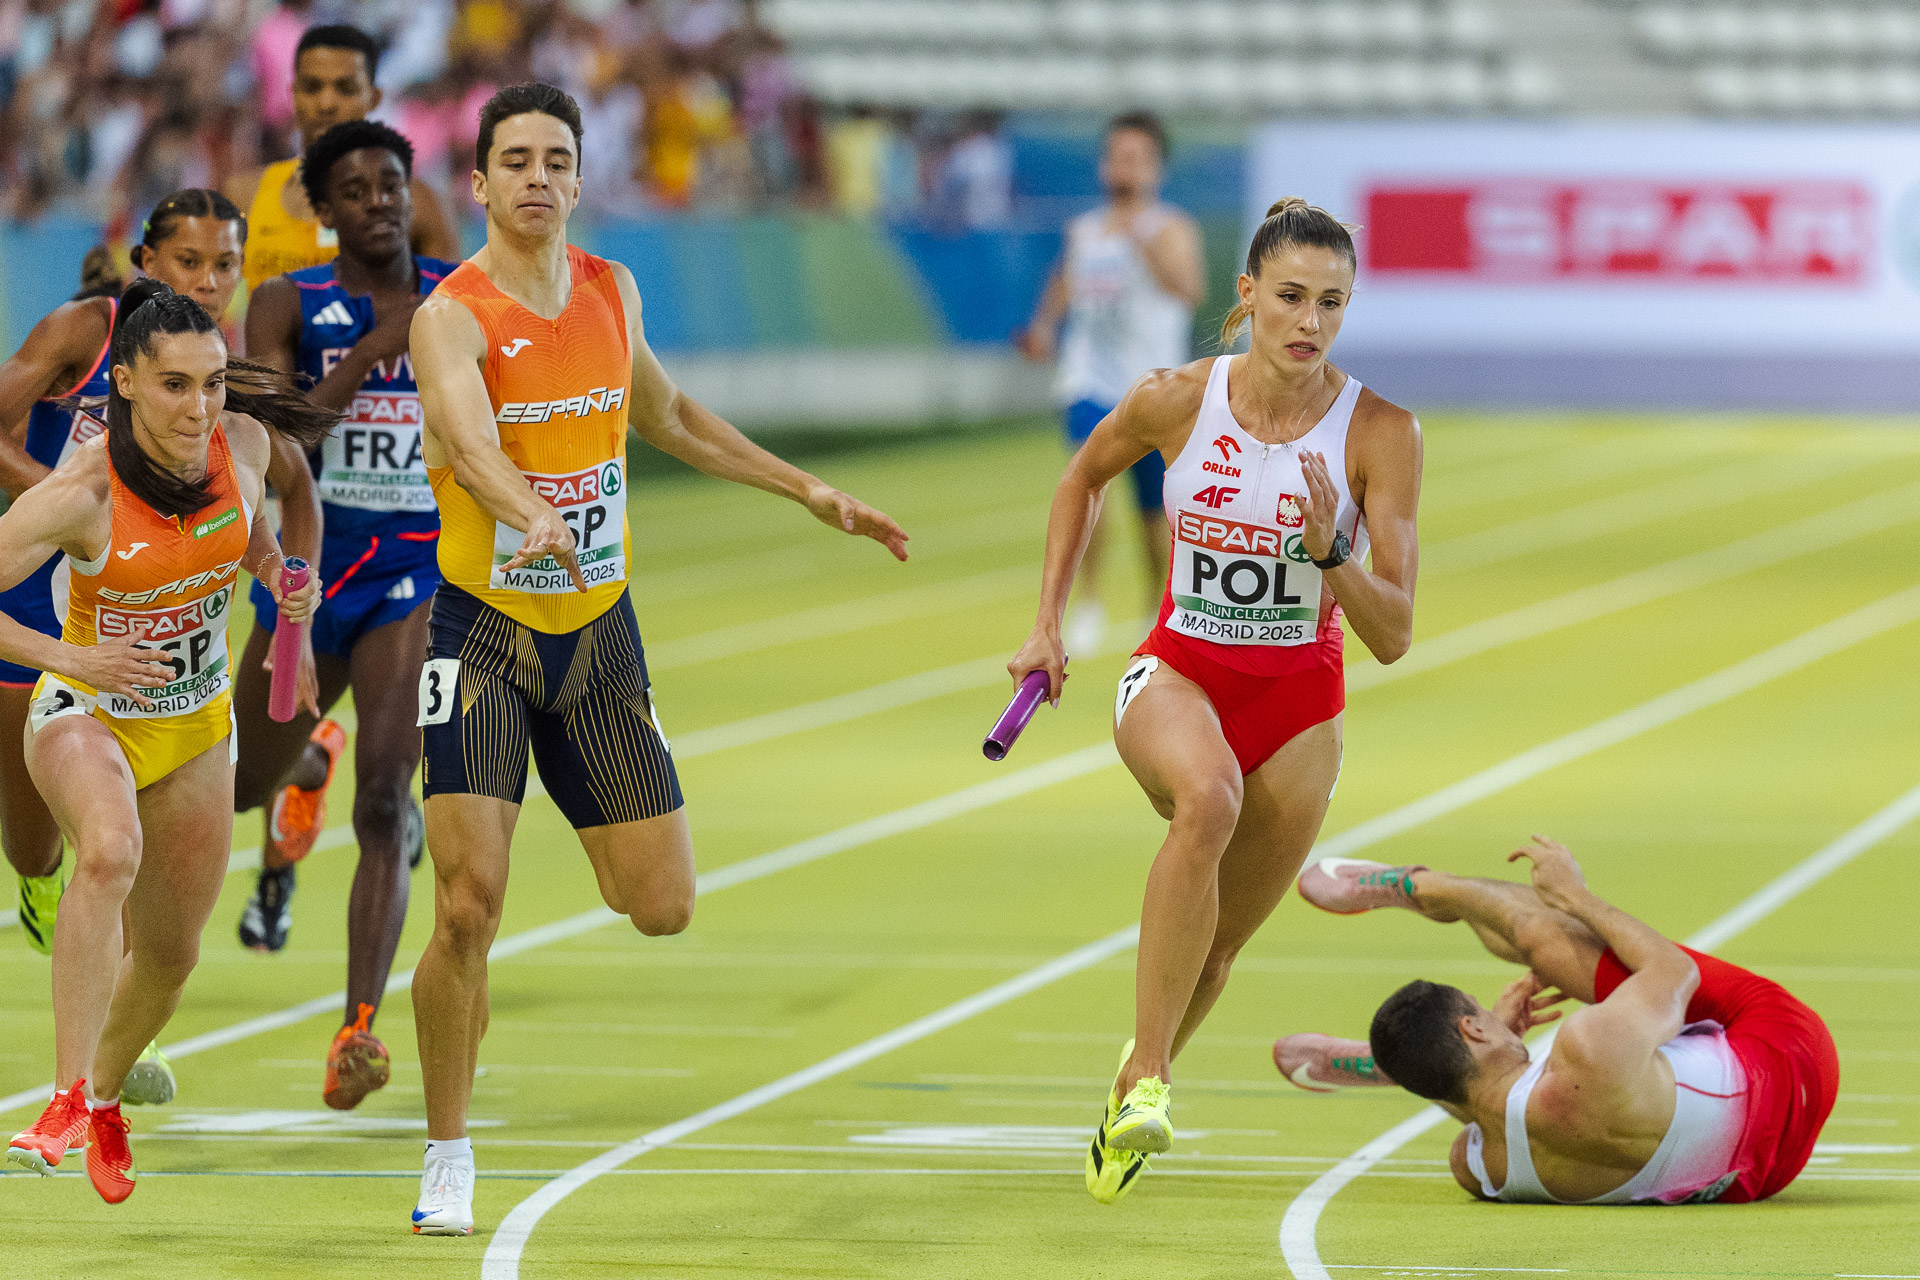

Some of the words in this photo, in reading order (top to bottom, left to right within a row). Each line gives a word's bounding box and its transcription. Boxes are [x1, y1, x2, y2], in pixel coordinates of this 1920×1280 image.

[1472, 186, 1862, 277] SPAR
[346, 398, 418, 422] PAR
[496, 387, 625, 423] ESPAÑA
[344, 430, 423, 469] FRA
[1202, 461, 1242, 478] ORLEN
[332, 486, 401, 503] MADRID
[526, 474, 597, 504] PAR
[1193, 485, 1241, 509] 4F
[208, 511, 237, 531] Iberdrola
[1180, 516, 1279, 556] SPAR
[583, 563, 616, 583] 2025
[1192, 551, 1302, 605] POL
[102, 605, 200, 638] SPAR
[1206, 602, 1232, 618] RUN
[1181, 613, 1254, 639] MADRID
[1259, 625, 1304, 640] 2025
[131, 630, 211, 682] SP
[111, 695, 190, 714] MADRID
[193, 675, 222, 706] 2025
[427, 670, 442, 716] 3
